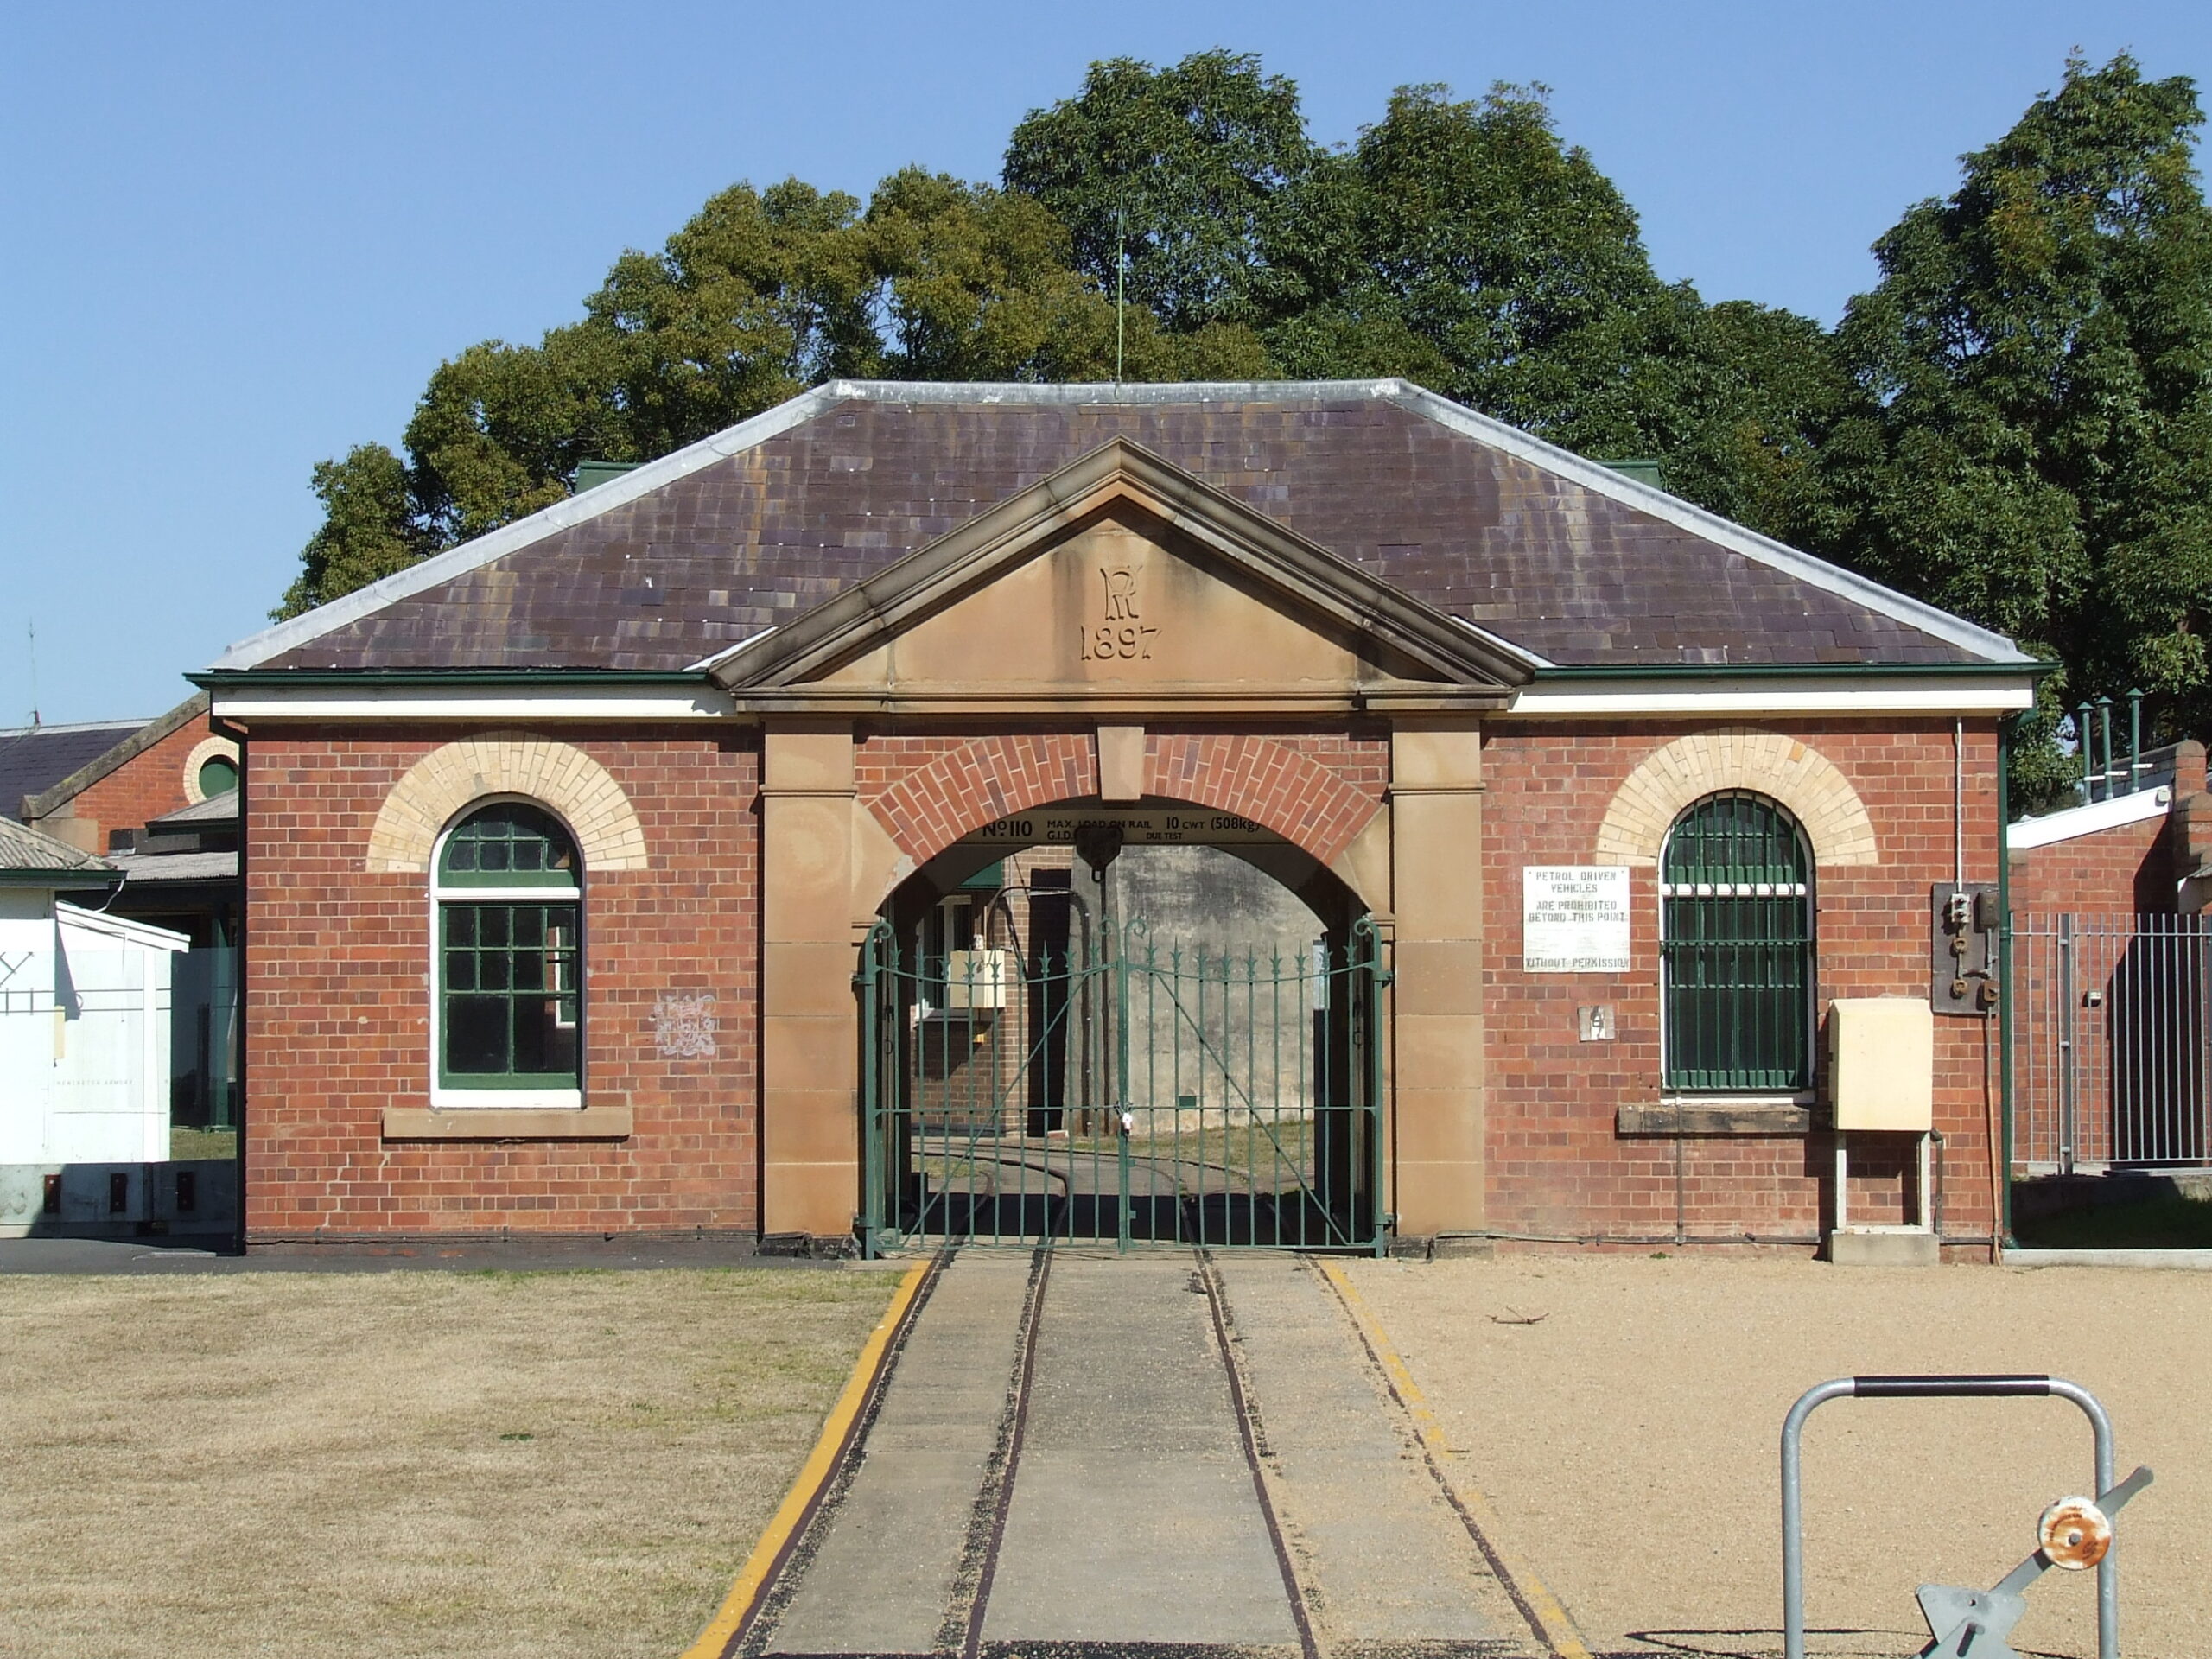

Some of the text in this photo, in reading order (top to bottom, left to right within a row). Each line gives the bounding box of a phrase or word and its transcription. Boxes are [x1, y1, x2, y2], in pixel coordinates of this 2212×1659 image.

[1080, 625, 1162, 661] 1897
[1009, 820, 1033, 837] 110
[1128, 820, 1152, 829] RAIL
[1166, 817, 1179, 830] 10
[1182, 821, 1205, 830] CWT
[1536, 871, 1617, 881] PETROL DRIVEN
[1551, 883, 1598, 893] VEHICLES
[1536, 900, 1617, 911] ARE PROHIBITED
[1529, 912, 1625, 922] BEYOND THIS POINT
[1526, 957, 1630, 968] WITHOUT PERMISSION
